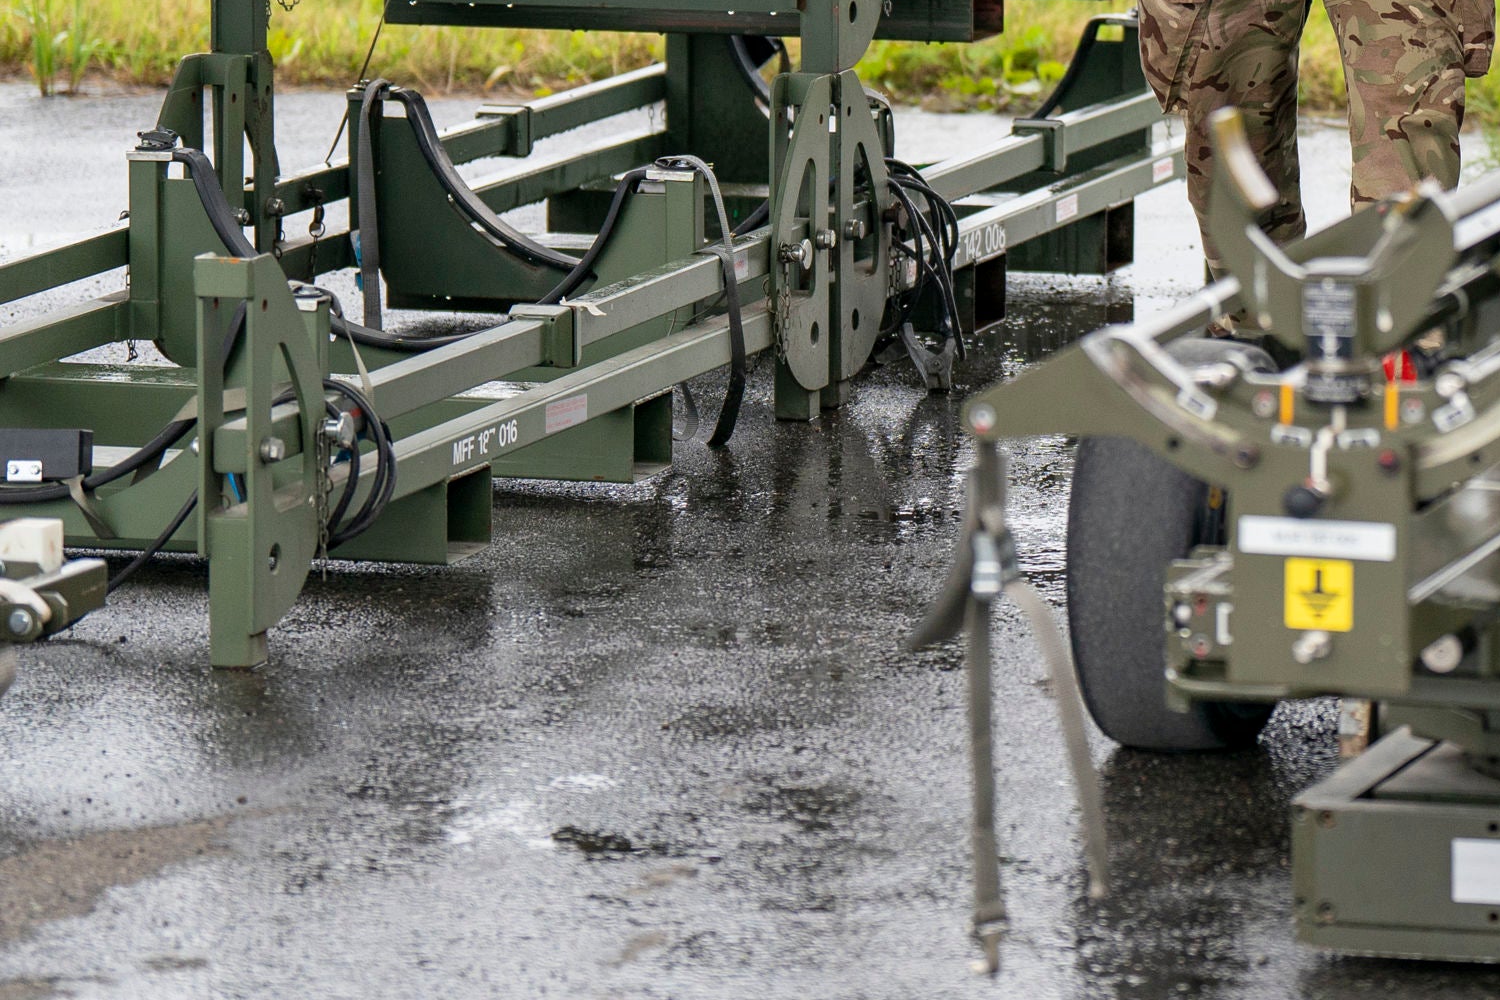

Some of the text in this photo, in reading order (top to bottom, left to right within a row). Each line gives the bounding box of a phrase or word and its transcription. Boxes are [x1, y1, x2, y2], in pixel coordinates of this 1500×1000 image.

[964, 231, 982, 261] 142
[453, 436, 475, 465] MFF
[498, 419, 518, 447] 016
